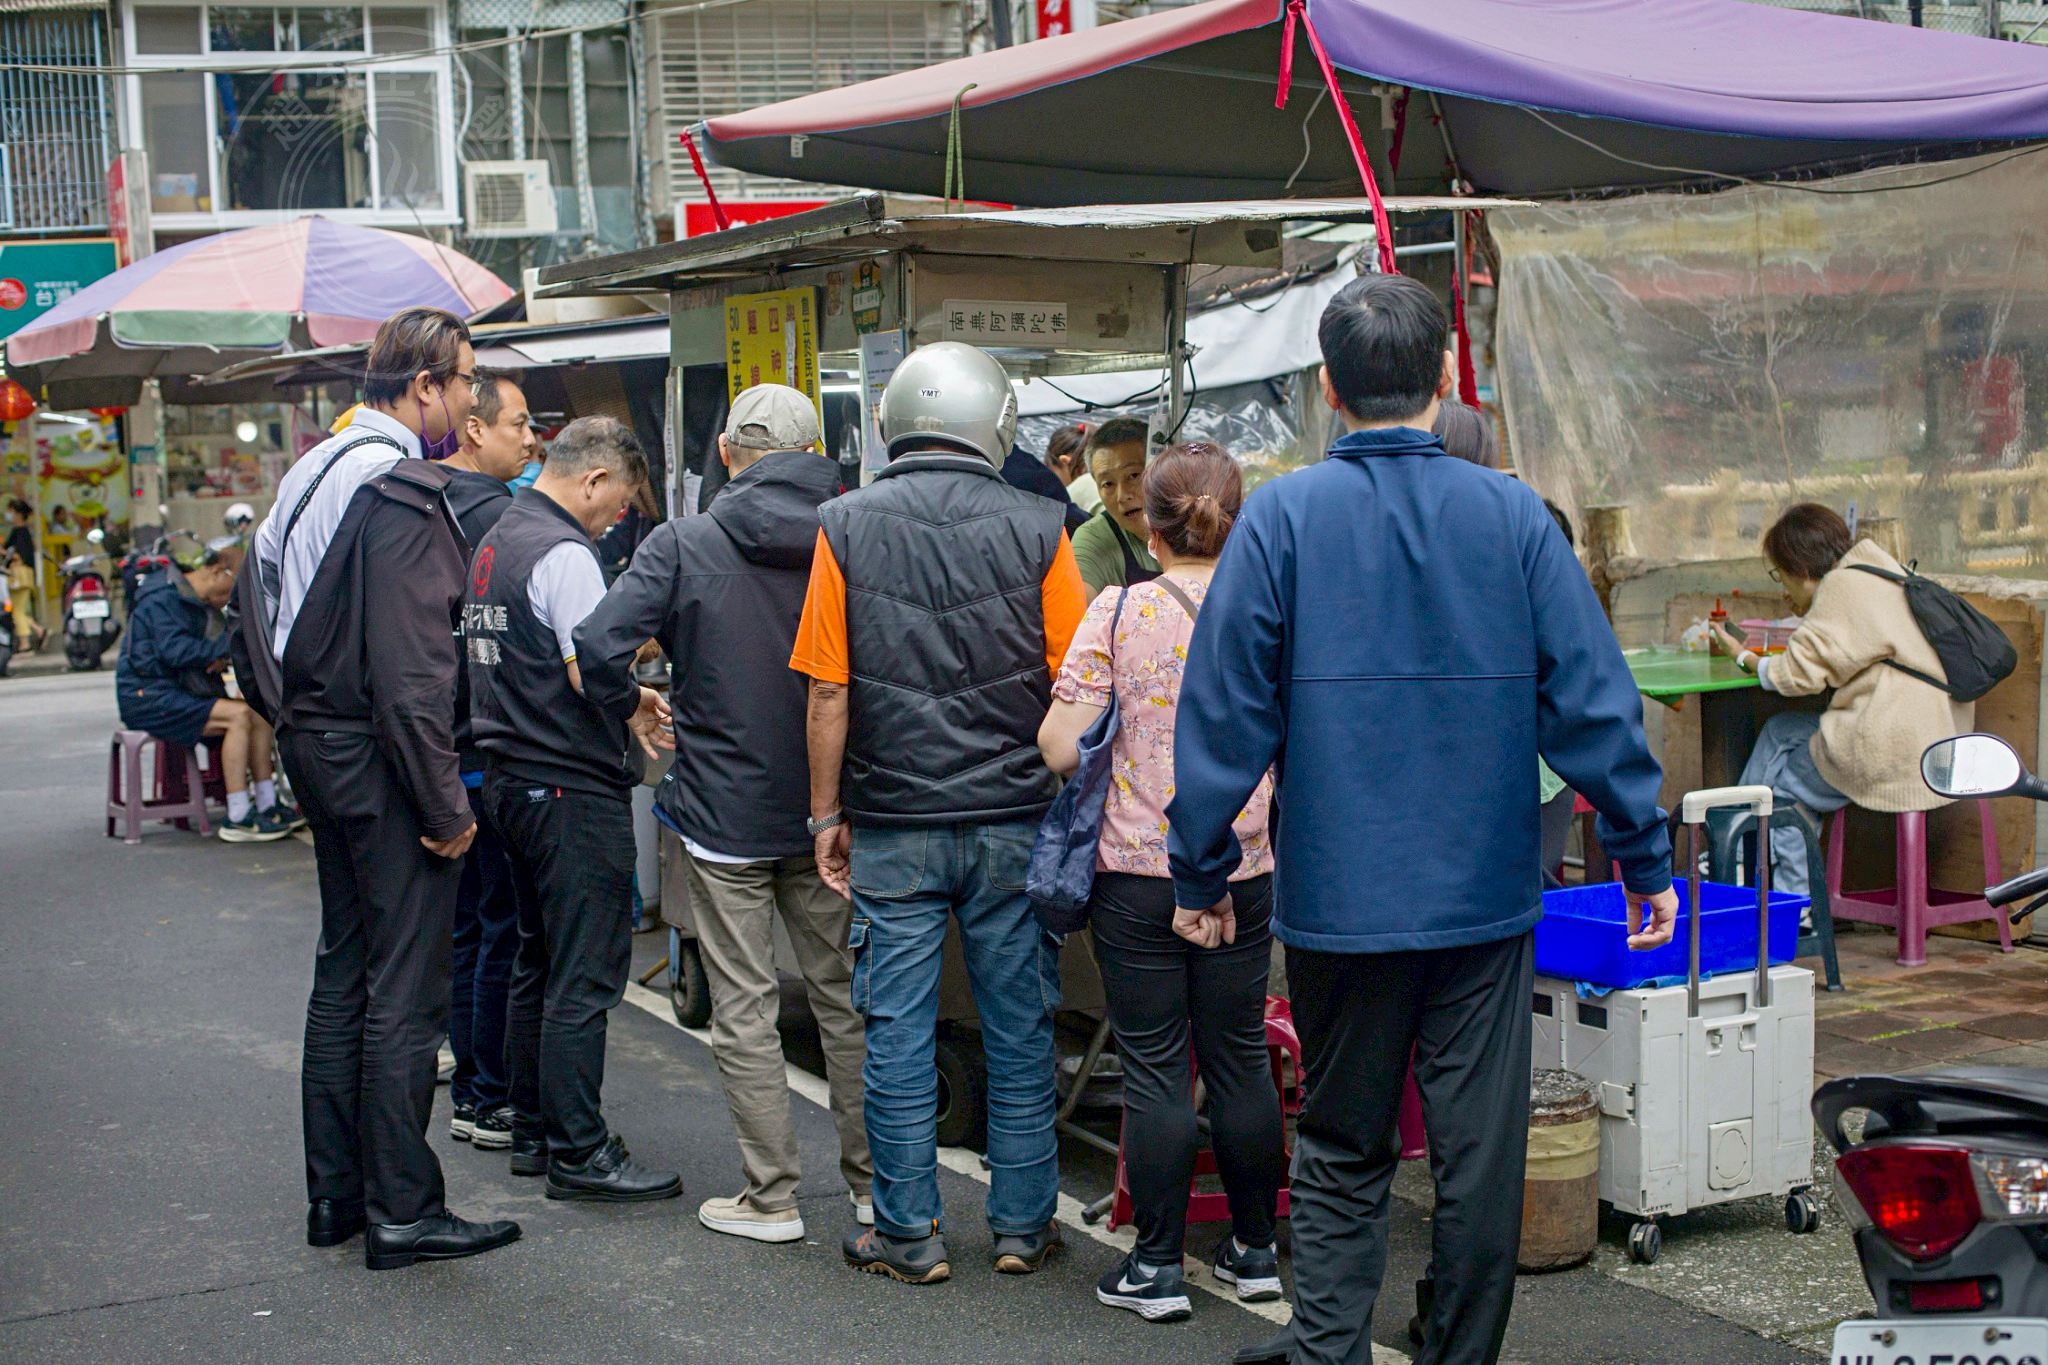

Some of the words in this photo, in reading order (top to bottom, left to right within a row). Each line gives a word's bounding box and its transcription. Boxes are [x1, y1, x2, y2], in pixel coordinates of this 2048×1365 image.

[949, 310, 1067, 334] 南無阿彌陀佛
[921, 389, 939, 398] YMT
